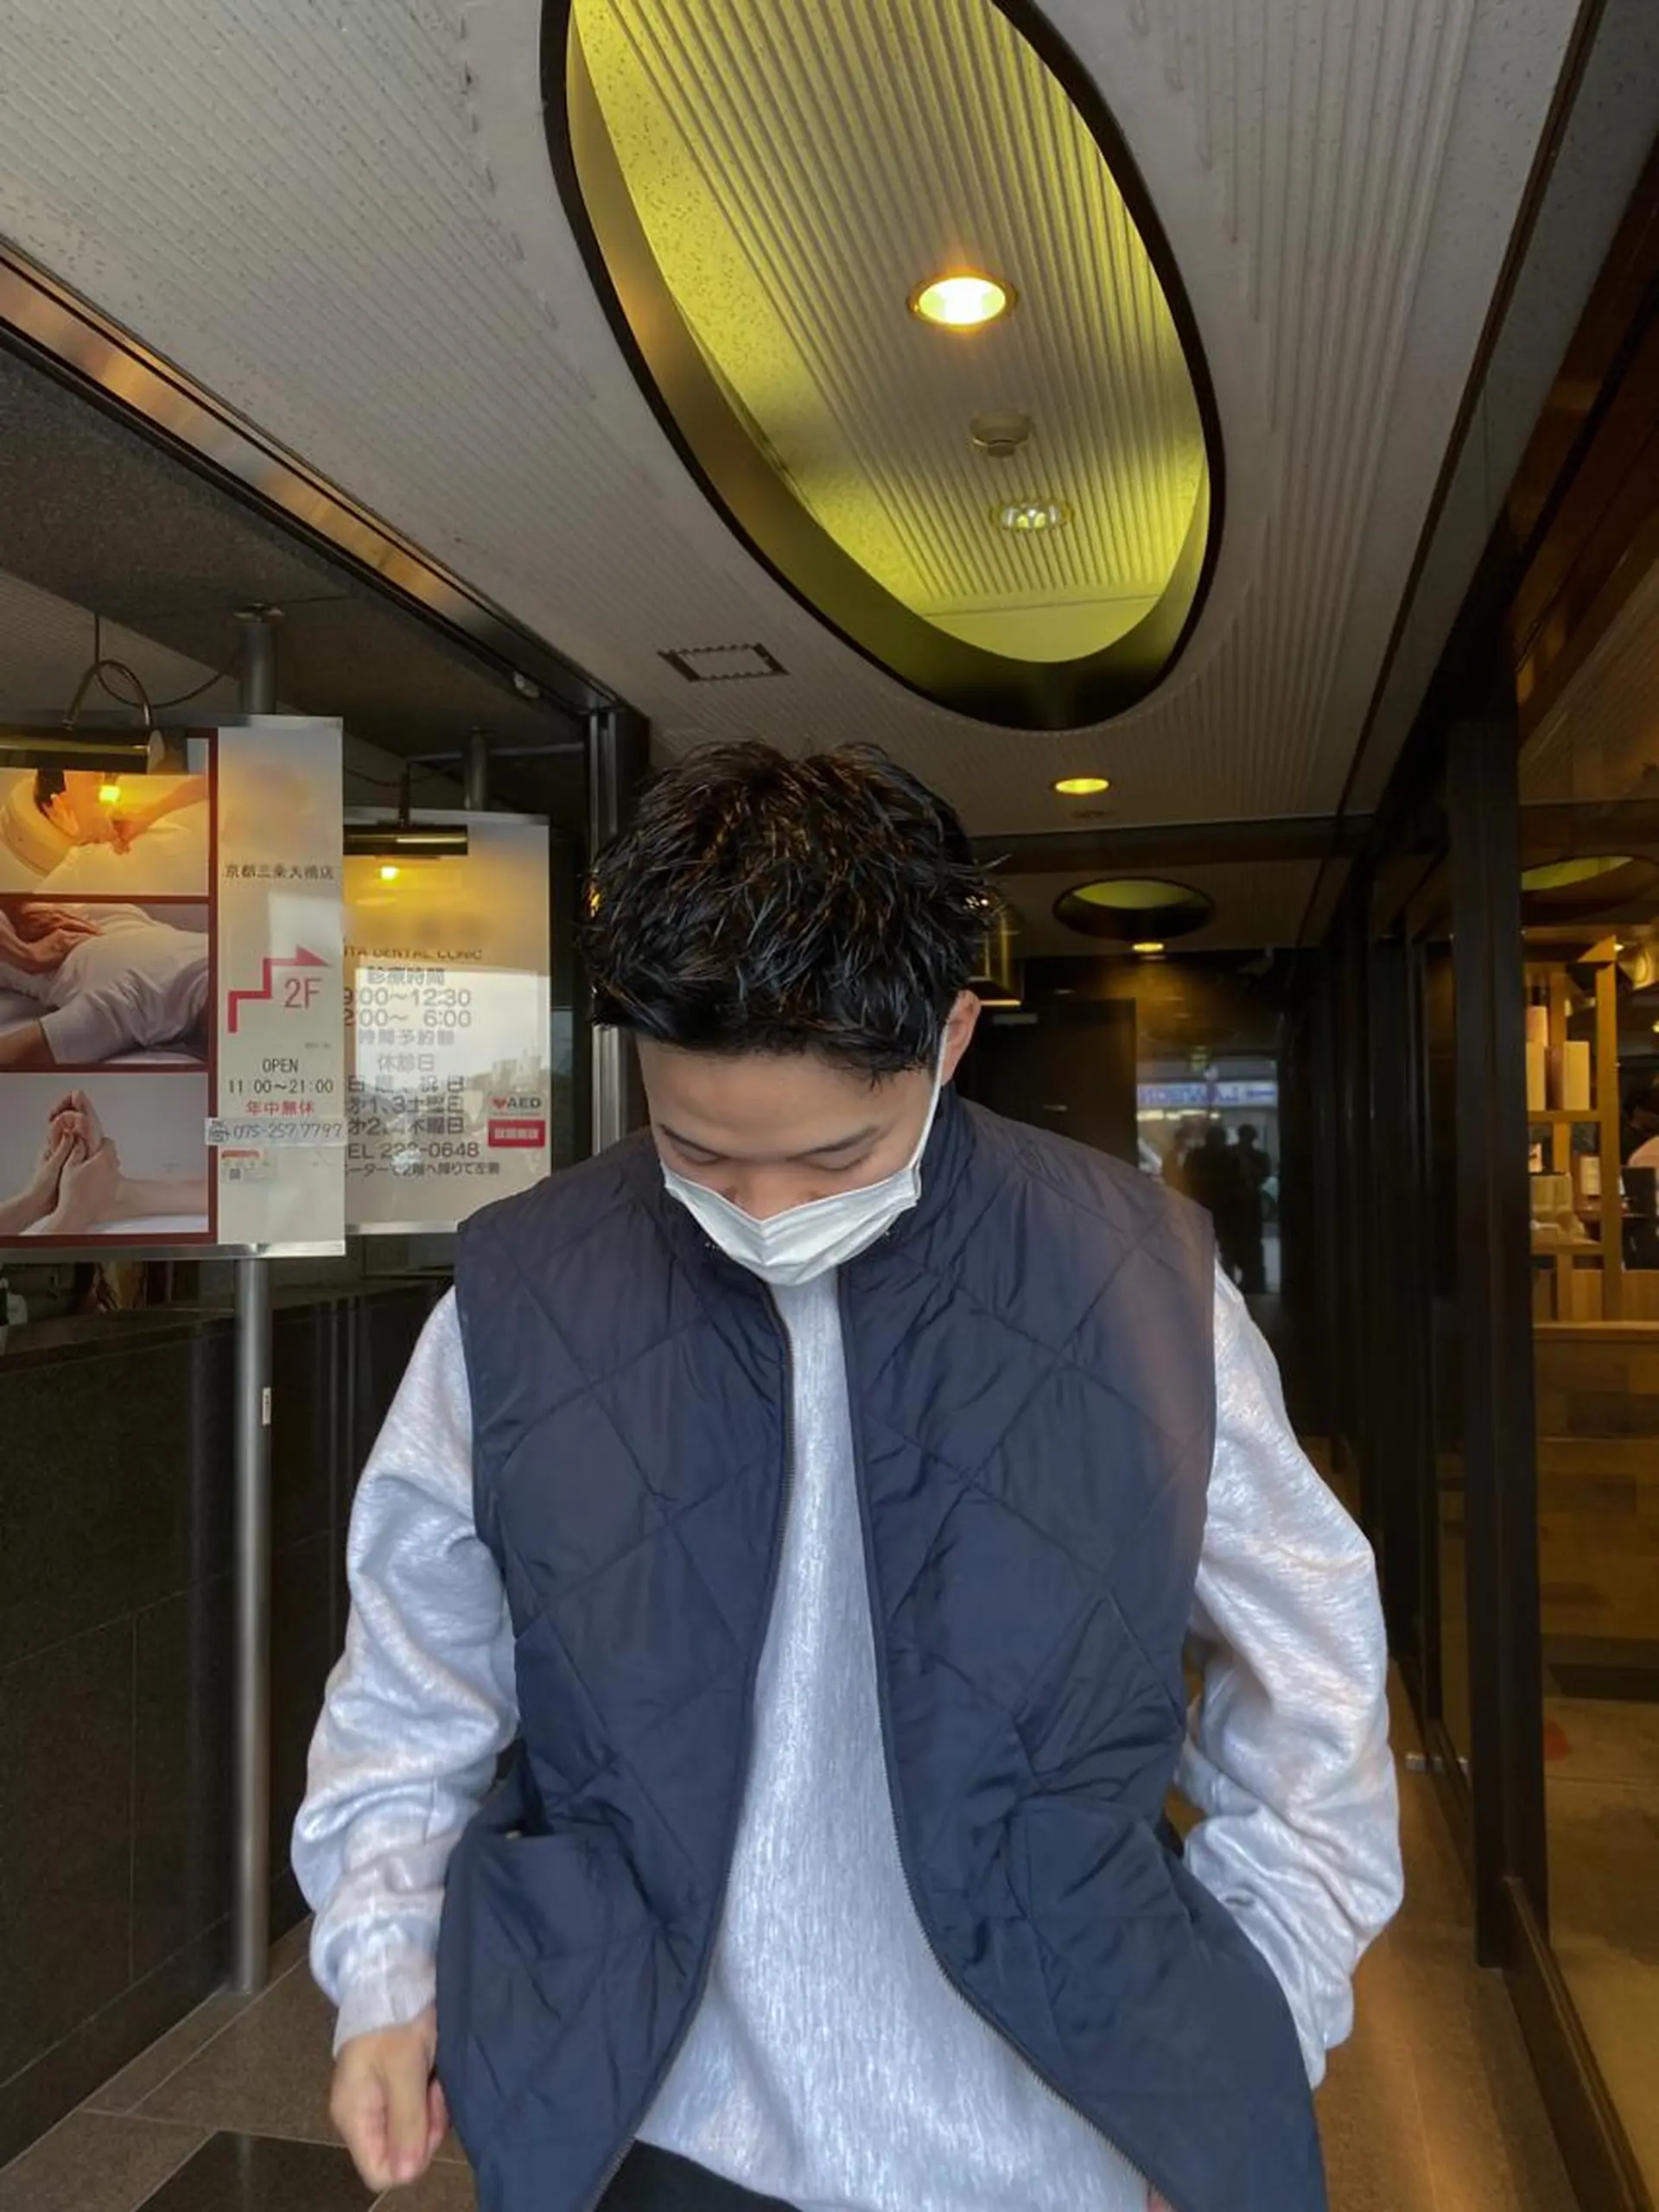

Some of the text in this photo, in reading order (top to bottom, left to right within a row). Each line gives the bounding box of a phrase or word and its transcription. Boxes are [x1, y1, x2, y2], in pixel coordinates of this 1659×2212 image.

[283, 977, 323, 1009] 2F
[262, 1058, 299, 1073] OPEN
[245, 1100, 315, 1116] 年中無休
[507, 1096, 542, 1109] AED
[347, 1143, 374, 1159] EL
